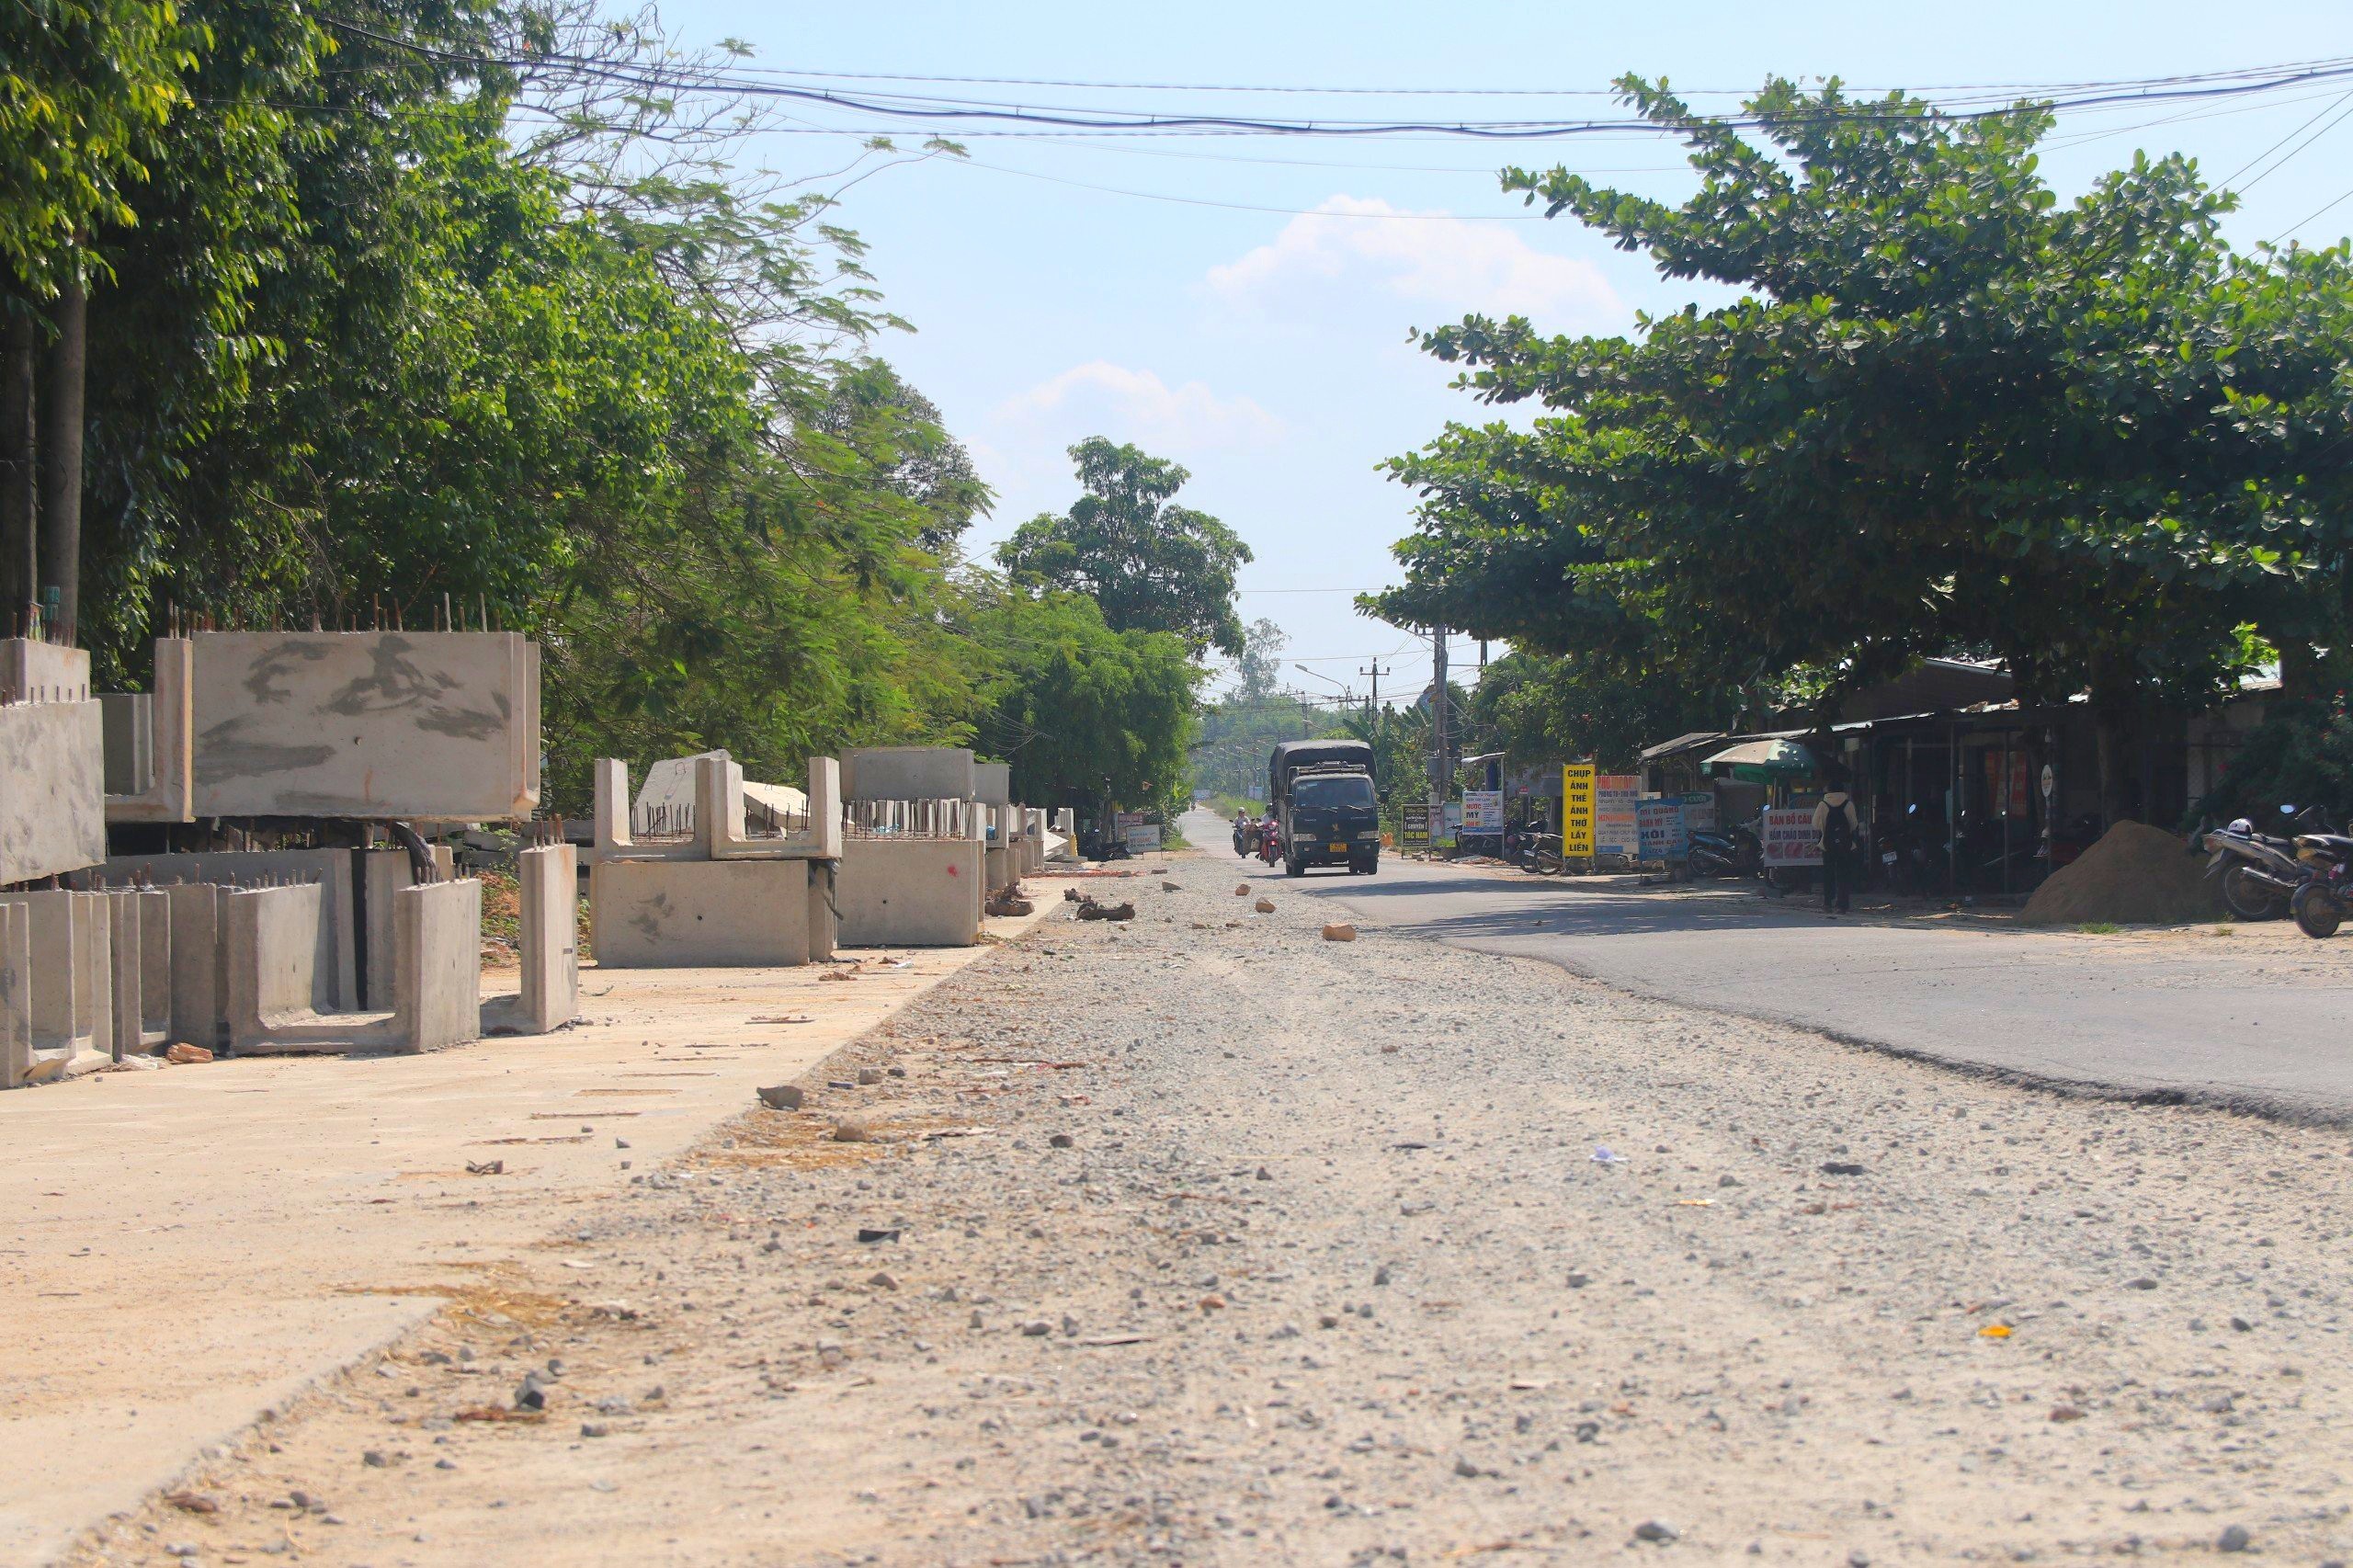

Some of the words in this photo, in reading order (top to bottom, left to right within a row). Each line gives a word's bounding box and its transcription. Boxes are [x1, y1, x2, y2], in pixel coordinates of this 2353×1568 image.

[1568, 770, 1591, 778] CHỤP
[1570, 780, 1588, 790] ẢNH
[1571, 792, 1586, 802] THẺ
[1570, 805, 1588, 814] ẢNH
[1571, 829, 1586, 839] LẤY
